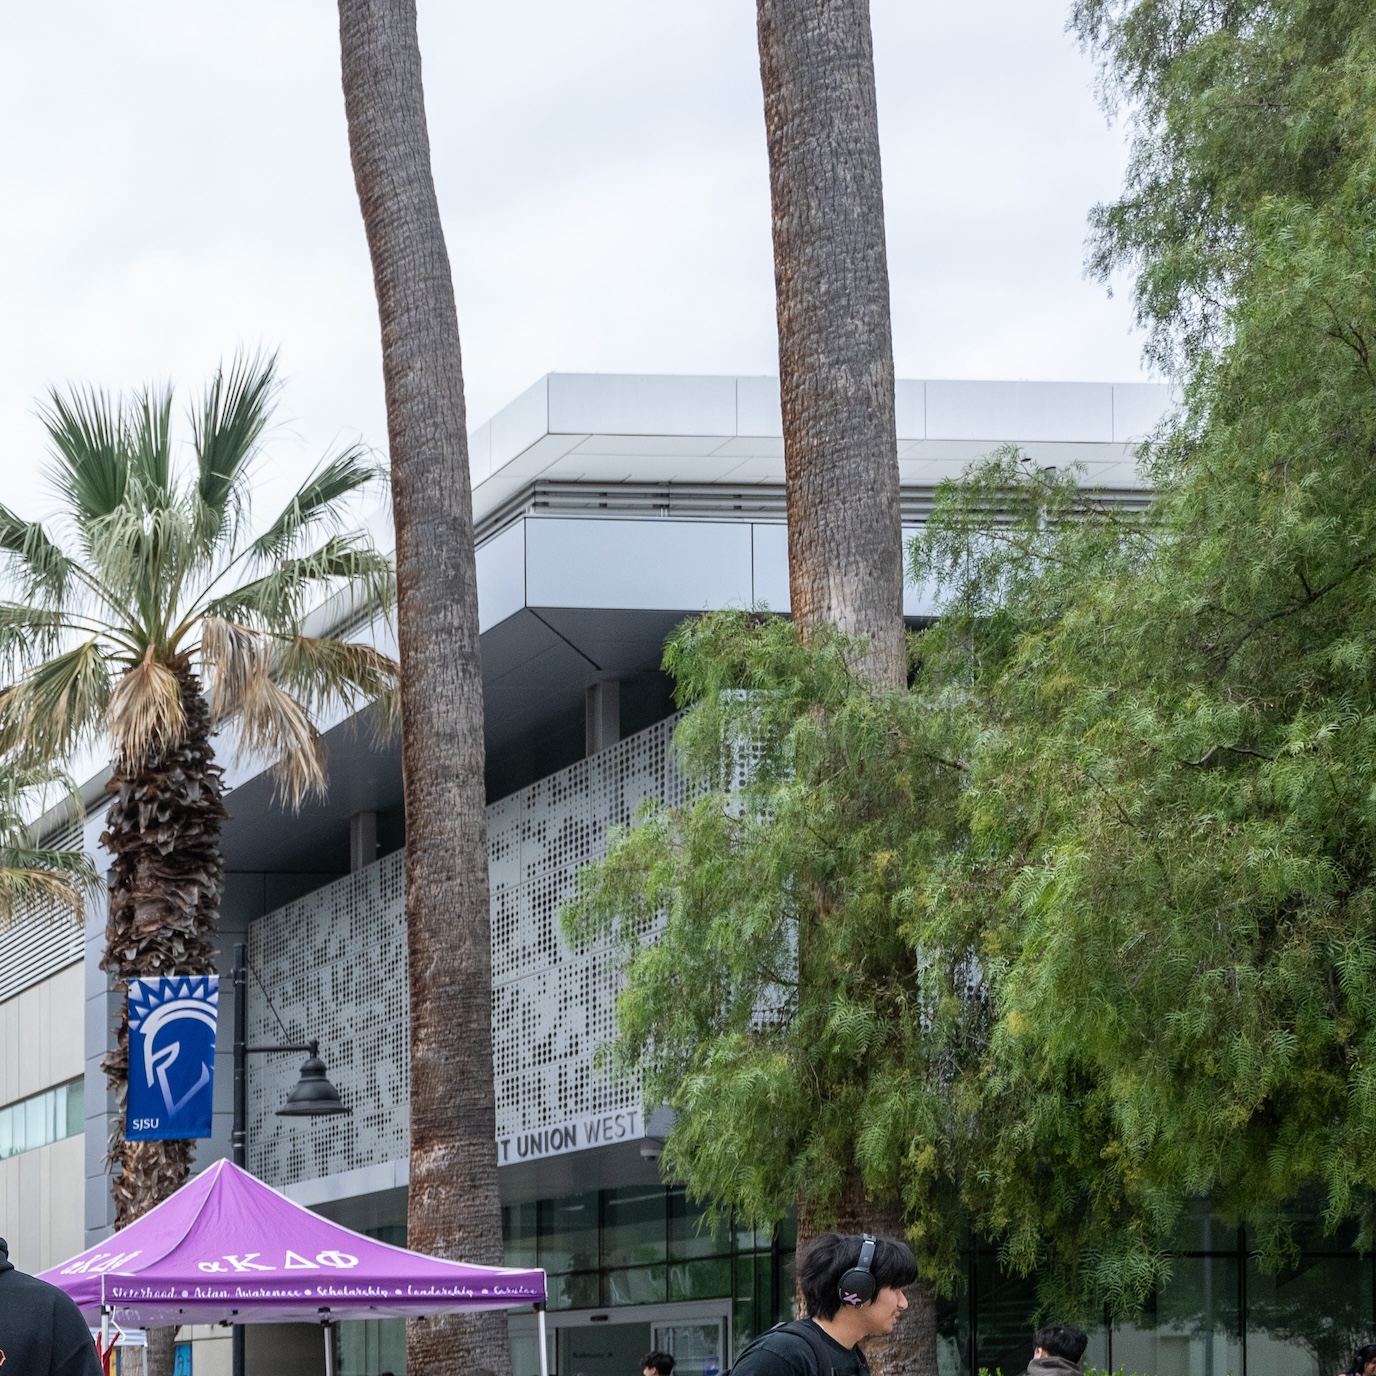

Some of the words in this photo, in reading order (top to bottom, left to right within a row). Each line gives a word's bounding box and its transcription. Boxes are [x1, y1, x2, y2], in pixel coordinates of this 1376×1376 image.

[132, 1118, 159, 1131] SJSU
[516, 1124, 577, 1158] UNION
[583, 1110, 638, 1144] WEST
[112, 1286, 177, 1299] Sisterhood
[194, 1286, 230, 1298] Asian
[235, 1286, 302, 1298] Awareness
[316, 1284, 391, 1298] Scholarship
[407, 1284, 475, 1298] Leadership
